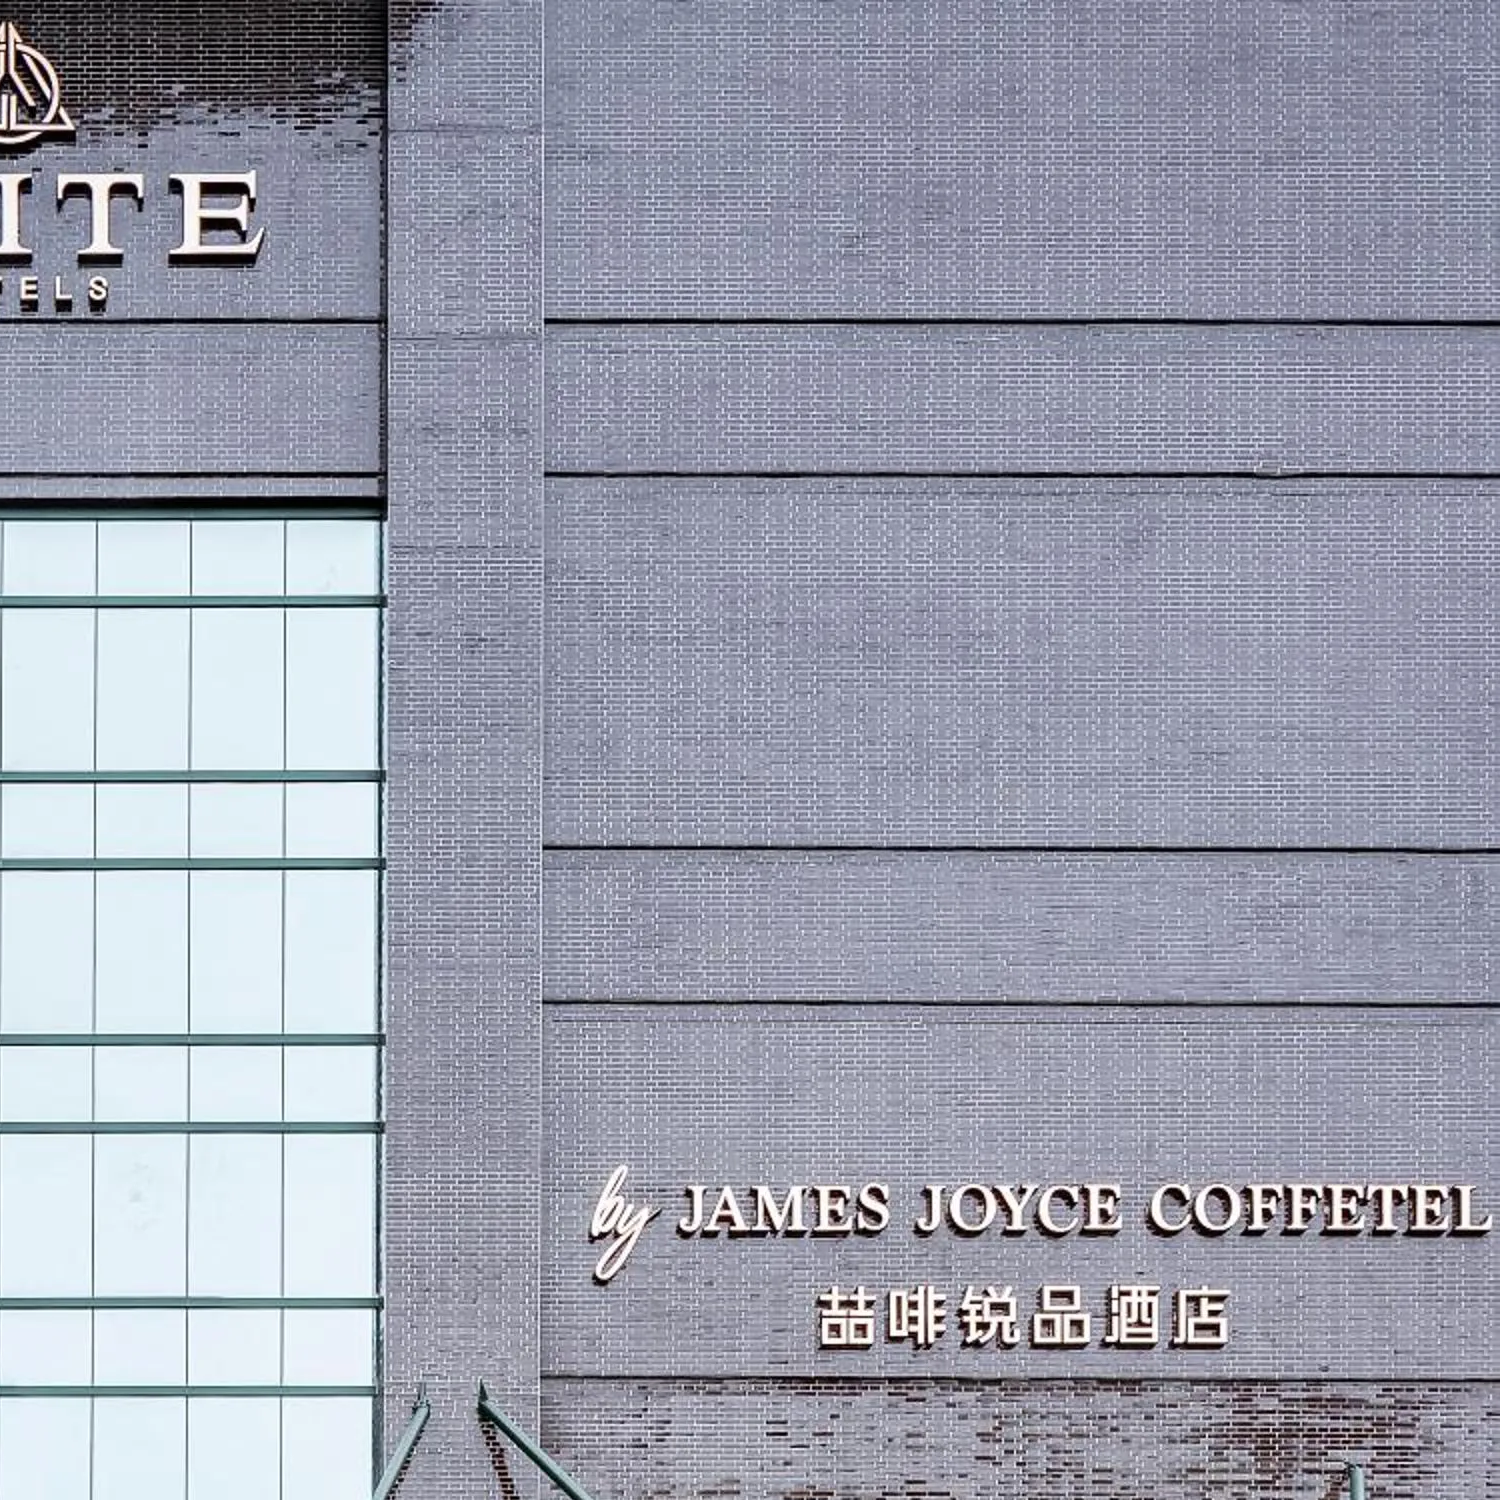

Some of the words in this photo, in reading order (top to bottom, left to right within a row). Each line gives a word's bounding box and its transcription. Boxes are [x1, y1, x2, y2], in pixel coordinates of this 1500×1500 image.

[591, 1165, 655, 1281] by
[678, 1184, 890, 1232] JAMES
[916, 1184, 1122, 1233] JOYCE
[1150, 1184, 1493, 1232] COFFETEL
[819, 1285, 1231, 1345] 喆啡锐品酒店
